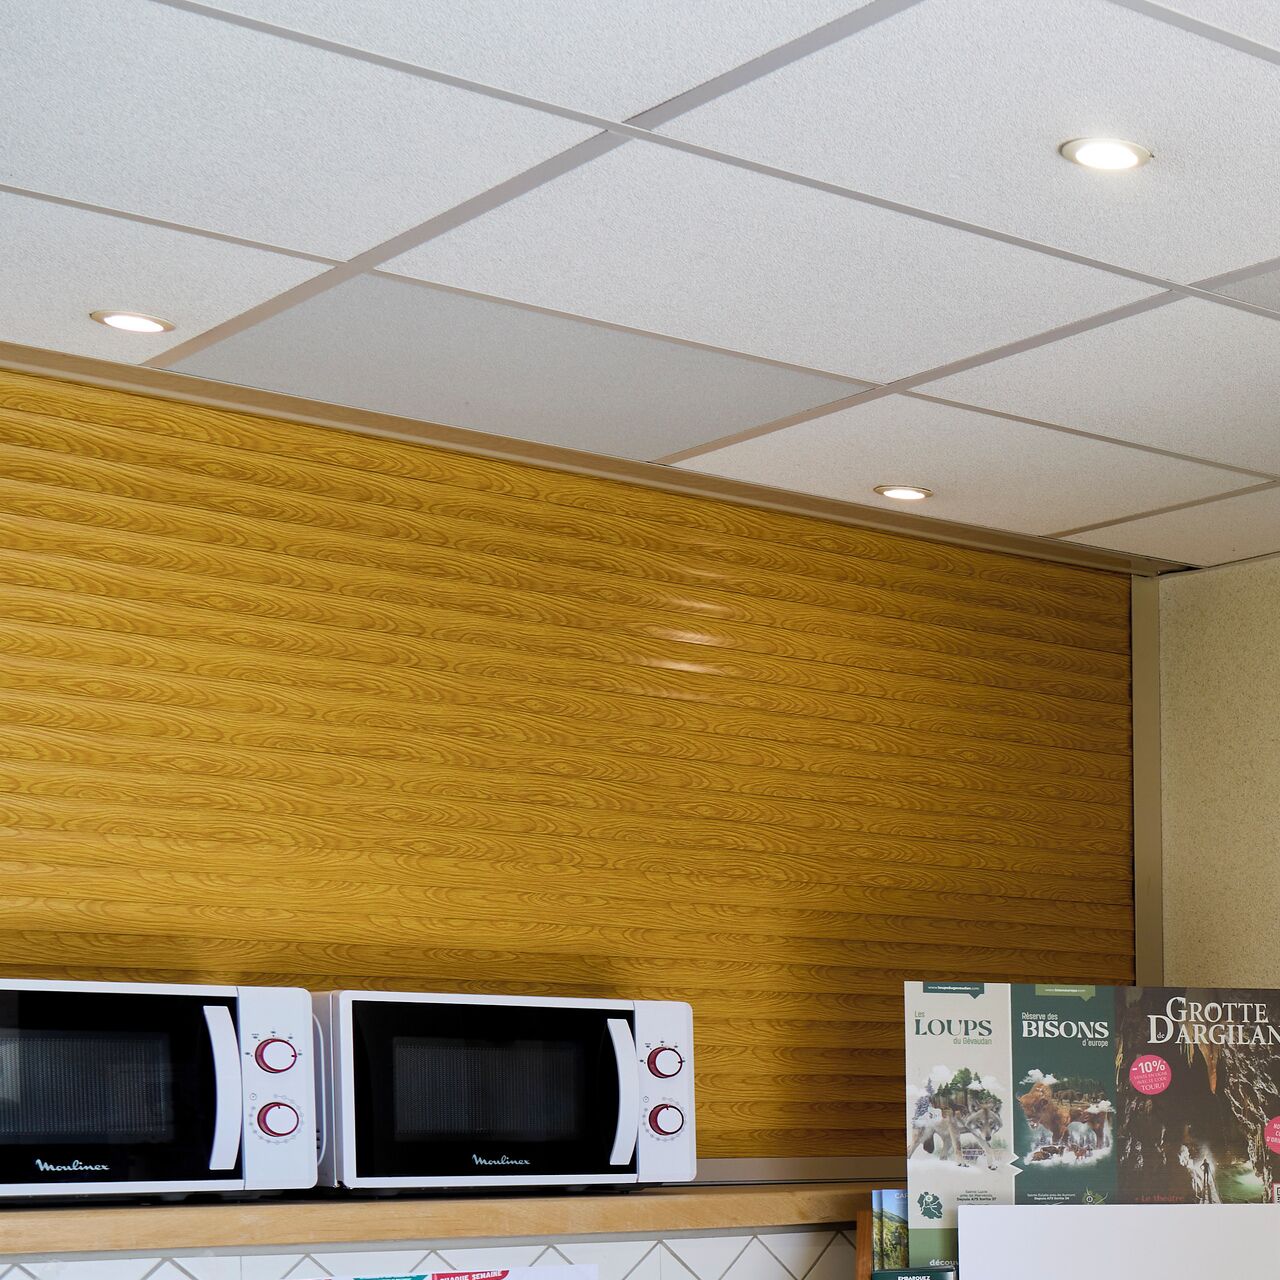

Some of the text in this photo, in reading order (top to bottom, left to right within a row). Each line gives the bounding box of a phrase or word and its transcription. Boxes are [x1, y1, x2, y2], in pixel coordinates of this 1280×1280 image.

[1166, 996, 1269, 1023] GROTTE
[1022, 1012, 1045, 1020] Réserve
[915, 1019, 992, 1036] LOUPS
[1022, 1020, 1109, 1039] BISONS
[963, 1037, 992, 1045] Gévaudan
[1082, 1039, 1108, 1047] d'europe
[35, 1159, 110, 1171] Moulinex
[472, 1154, 530, 1165] Moulinex
[472, 1271, 502, 1280] SEMAINE
